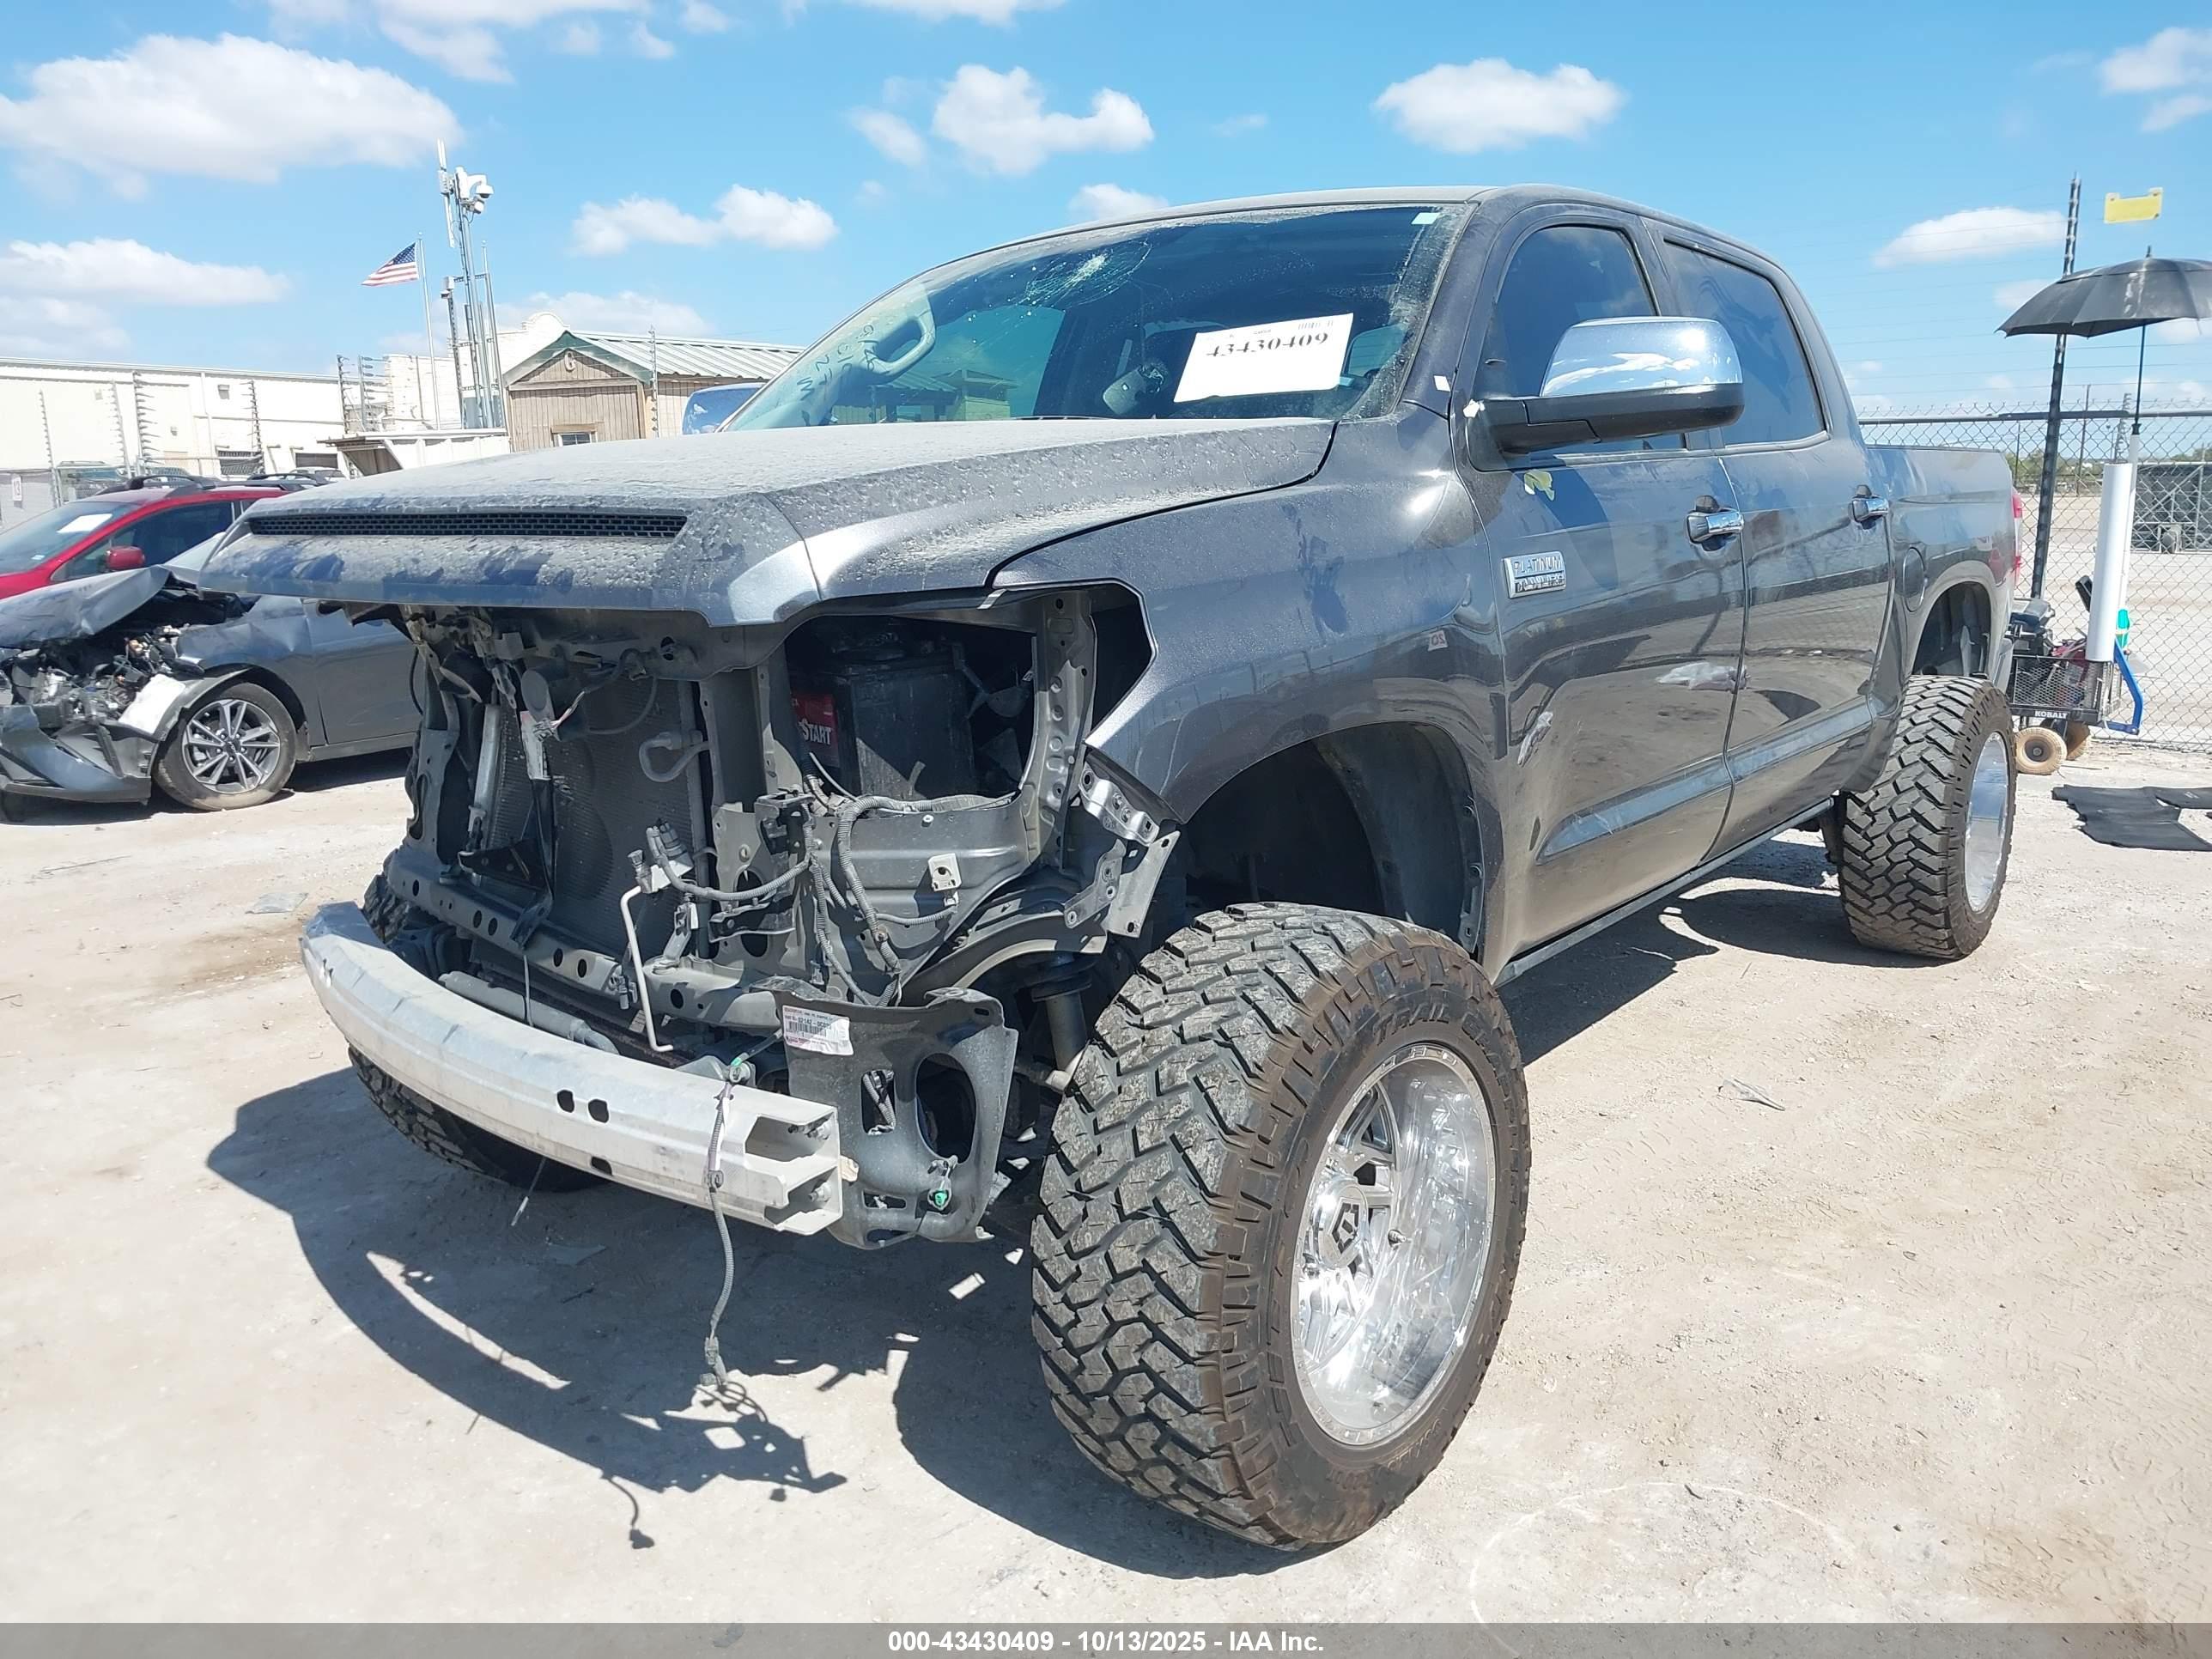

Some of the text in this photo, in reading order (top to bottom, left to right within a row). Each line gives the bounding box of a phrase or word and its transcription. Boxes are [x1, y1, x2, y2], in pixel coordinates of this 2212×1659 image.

[1206, 332, 1328, 356] 43430409
[1514, 556, 1562, 575] PLATINUM
[2034, 710, 2068, 720] KOBALT
